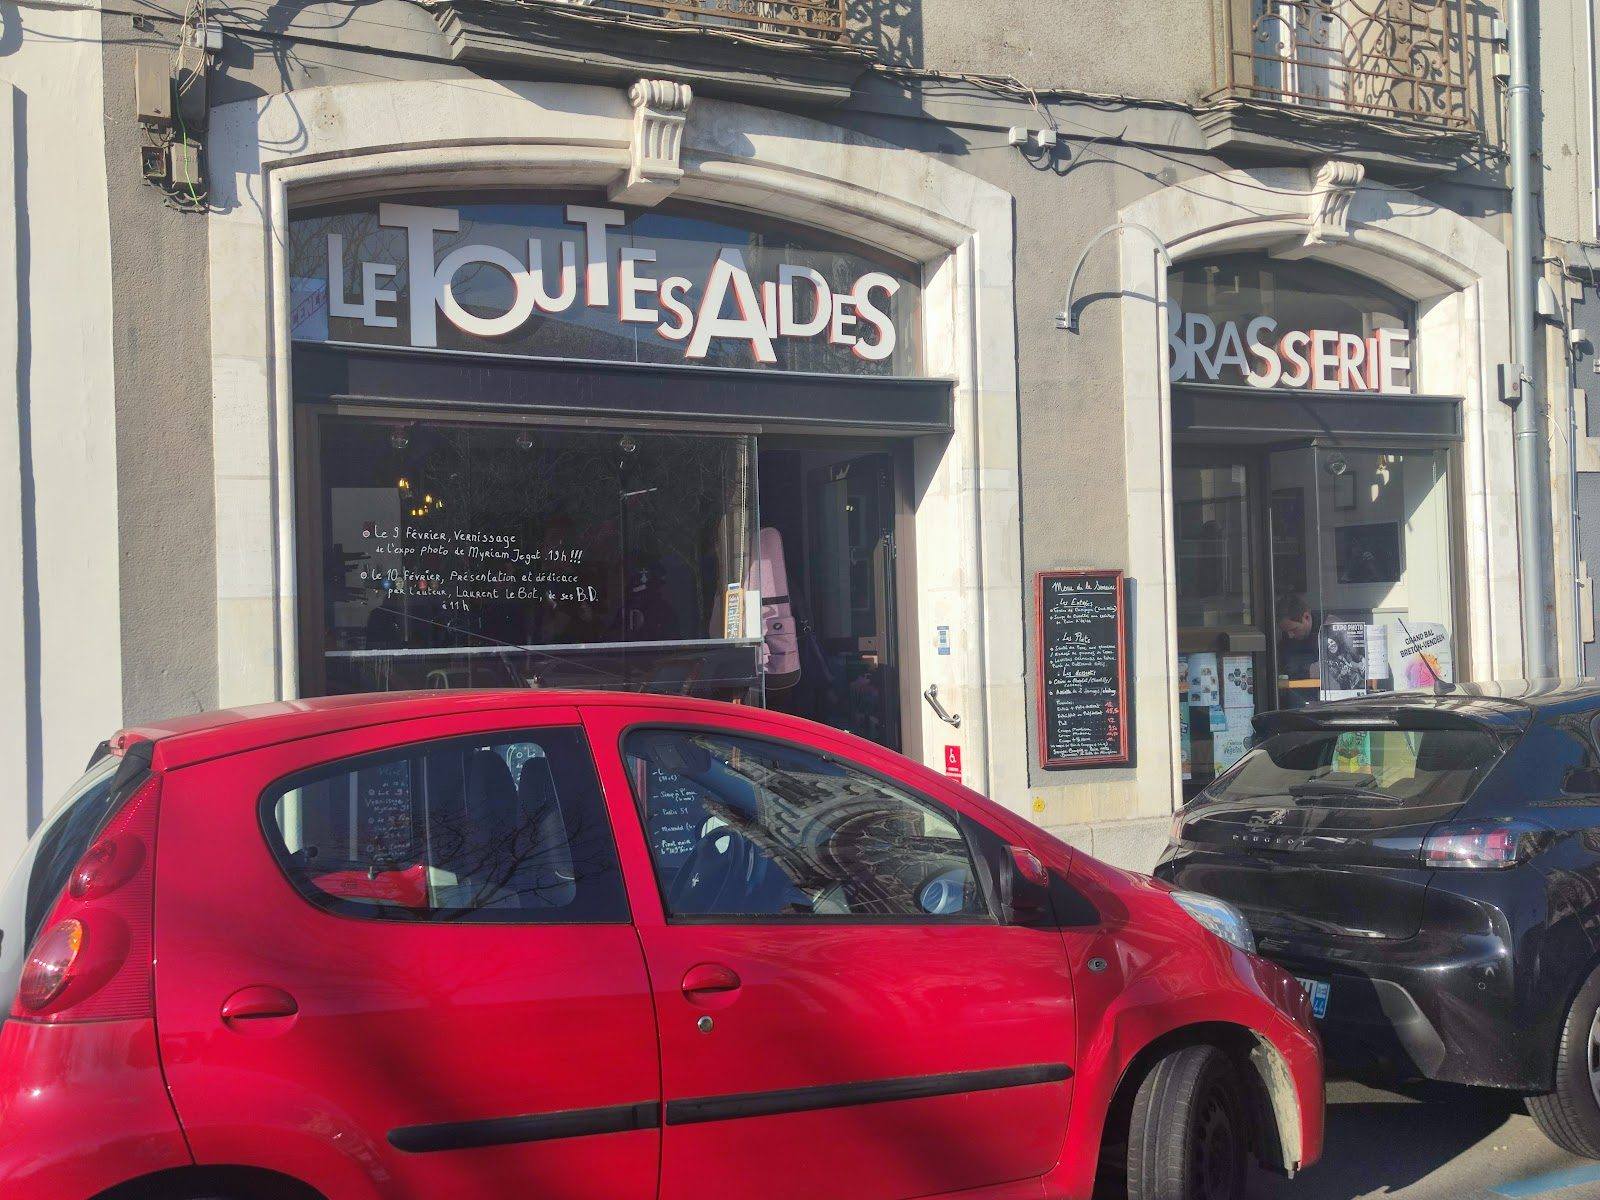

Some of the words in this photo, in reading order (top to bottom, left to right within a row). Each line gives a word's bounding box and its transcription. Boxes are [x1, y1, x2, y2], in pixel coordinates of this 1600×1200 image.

[328, 233, 398, 328] LE
[379, 202, 696, 347] TOUTES
[685, 247, 901, 363] AIDES
[1167, 295, 1411, 394] BRASSERIE
[393, 526, 400, 539] 9
[453, 530, 516, 549] Vernissage
[376, 545, 385, 553] de
[387, 542, 415, 557] l'expo
[420, 544, 449, 557] photo
[454, 546, 465, 556] de
[468, 546, 510, 561] Myriam
[511, 549, 541, 565] Jegat
[386, 569, 398, 581] 10
[450, 570, 516, 583] Présentation
[522, 571, 533, 582] et
[535, 571, 578, 583] dédicace
[388, 587, 405, 600] par
[456, 586, 499, 599] Laurent
[560, 592, 574, 601] ses
[1052, 582, 1074, 592] Menu
[1062, 632, 1072, 642] Les
[1405, 633, 1424, 645] GRAND
[1424, 629, 1434, 638] BAL
[1232, 834, 1306, 846] PEUGEOT
